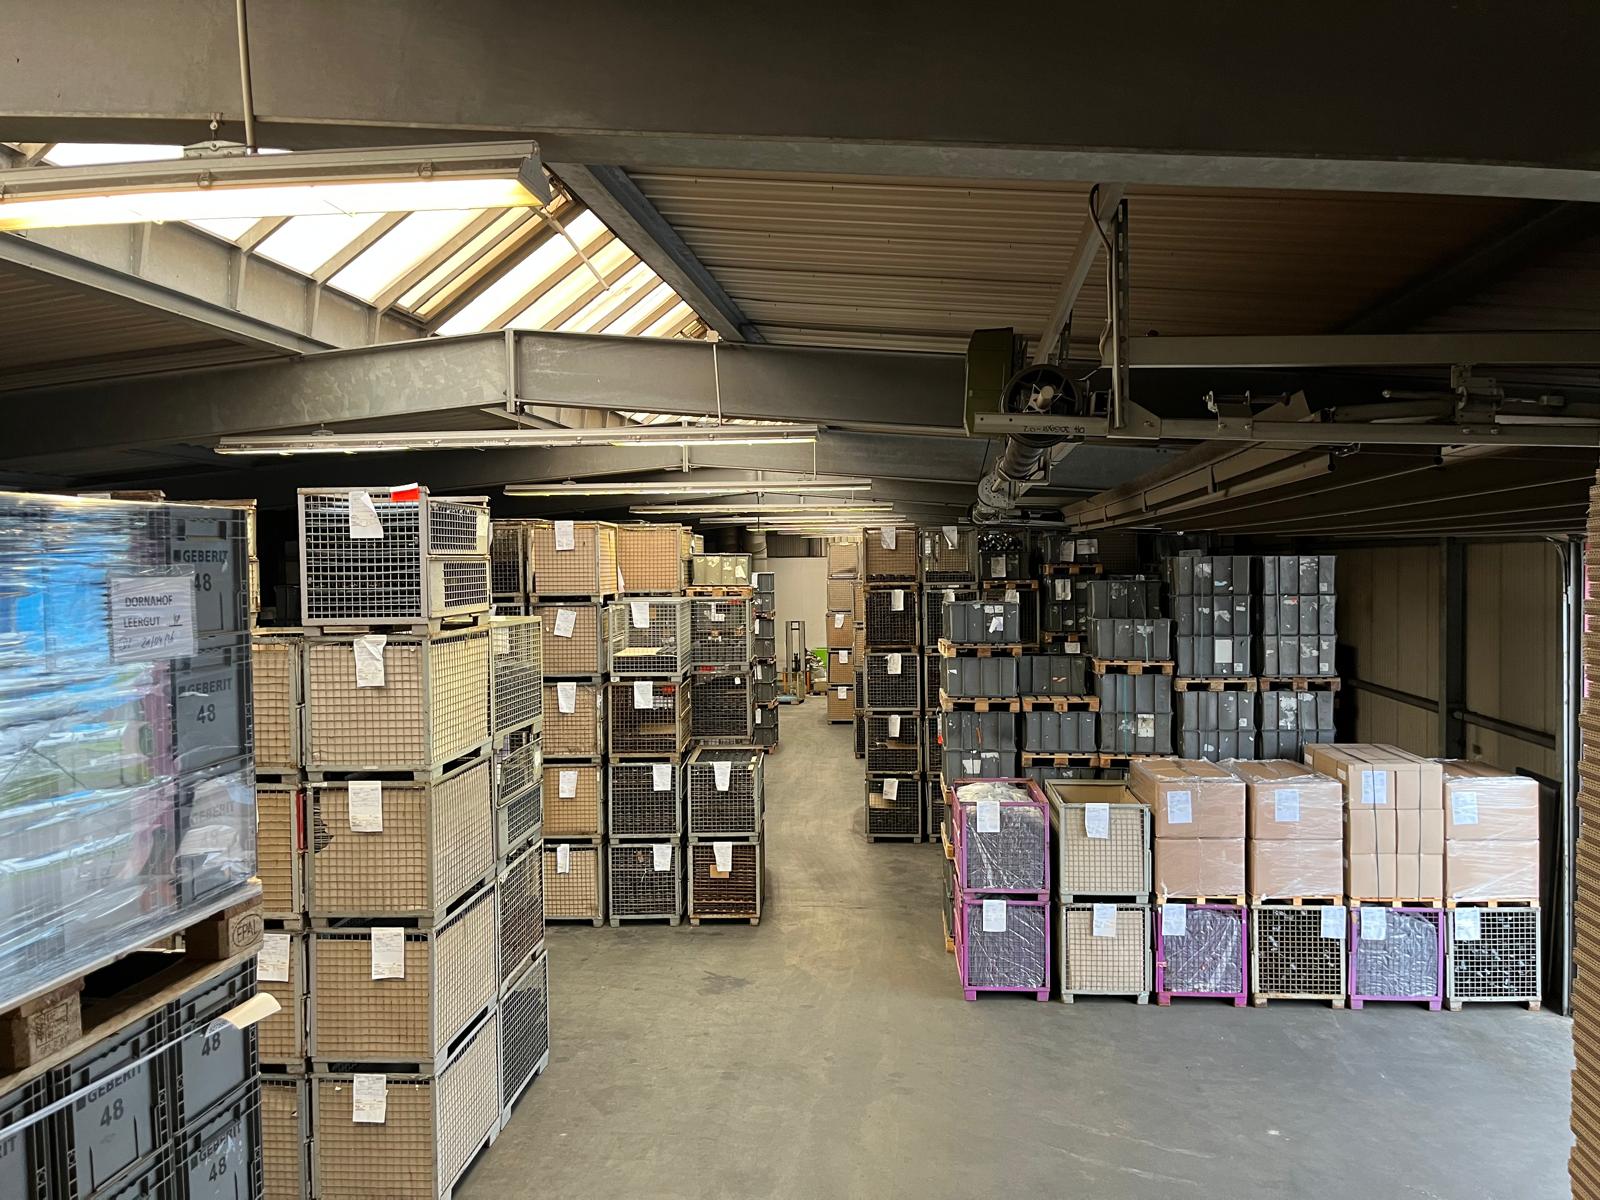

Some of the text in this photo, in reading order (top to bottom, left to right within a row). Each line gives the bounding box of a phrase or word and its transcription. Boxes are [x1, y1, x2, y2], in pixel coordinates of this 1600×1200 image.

[183, 550, 228, 563] GEBERIT
[195, 573, 211, 591] 48
[125, 595, 173, 607] DORNAHOF
[124, 617, 160, 628] LEERGUT
[187, 678, 232, 693] GEBERIT
[196, 704, 215, 724] 48
[202, 1032, 221, 1056] 48
[100, 1098, 124, 1126] 48
[209, 1157, 226, 1181] 48
